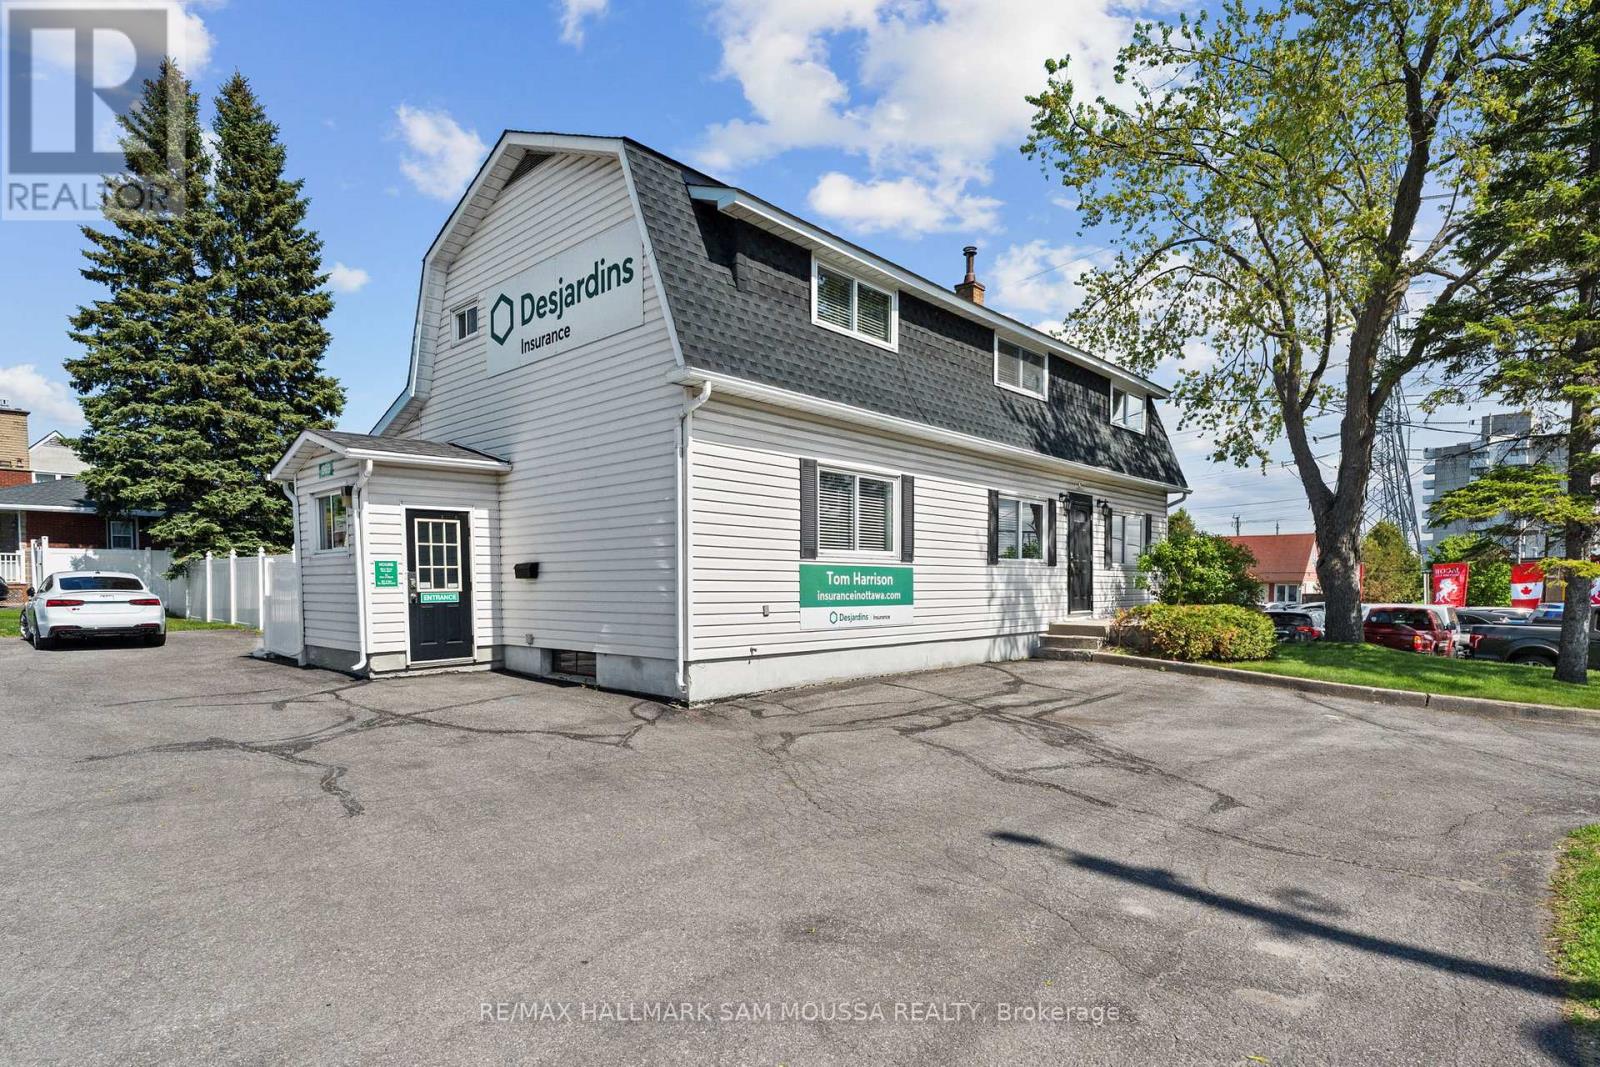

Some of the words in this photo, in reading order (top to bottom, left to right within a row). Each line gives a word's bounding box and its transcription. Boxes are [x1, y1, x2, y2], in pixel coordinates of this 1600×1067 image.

[520, 257, 634, 326] Desjardins
[521, 326, 571, 354] Insurance
[826, 571, 850, 585] Tom
[853, 571, 893, 585] Harrison
[423, 594, 457, 602] ENTRANCE
[817, 590, 901, 601] insuranceinottawa.com
[839, 613, 869, 622] Desjardins
